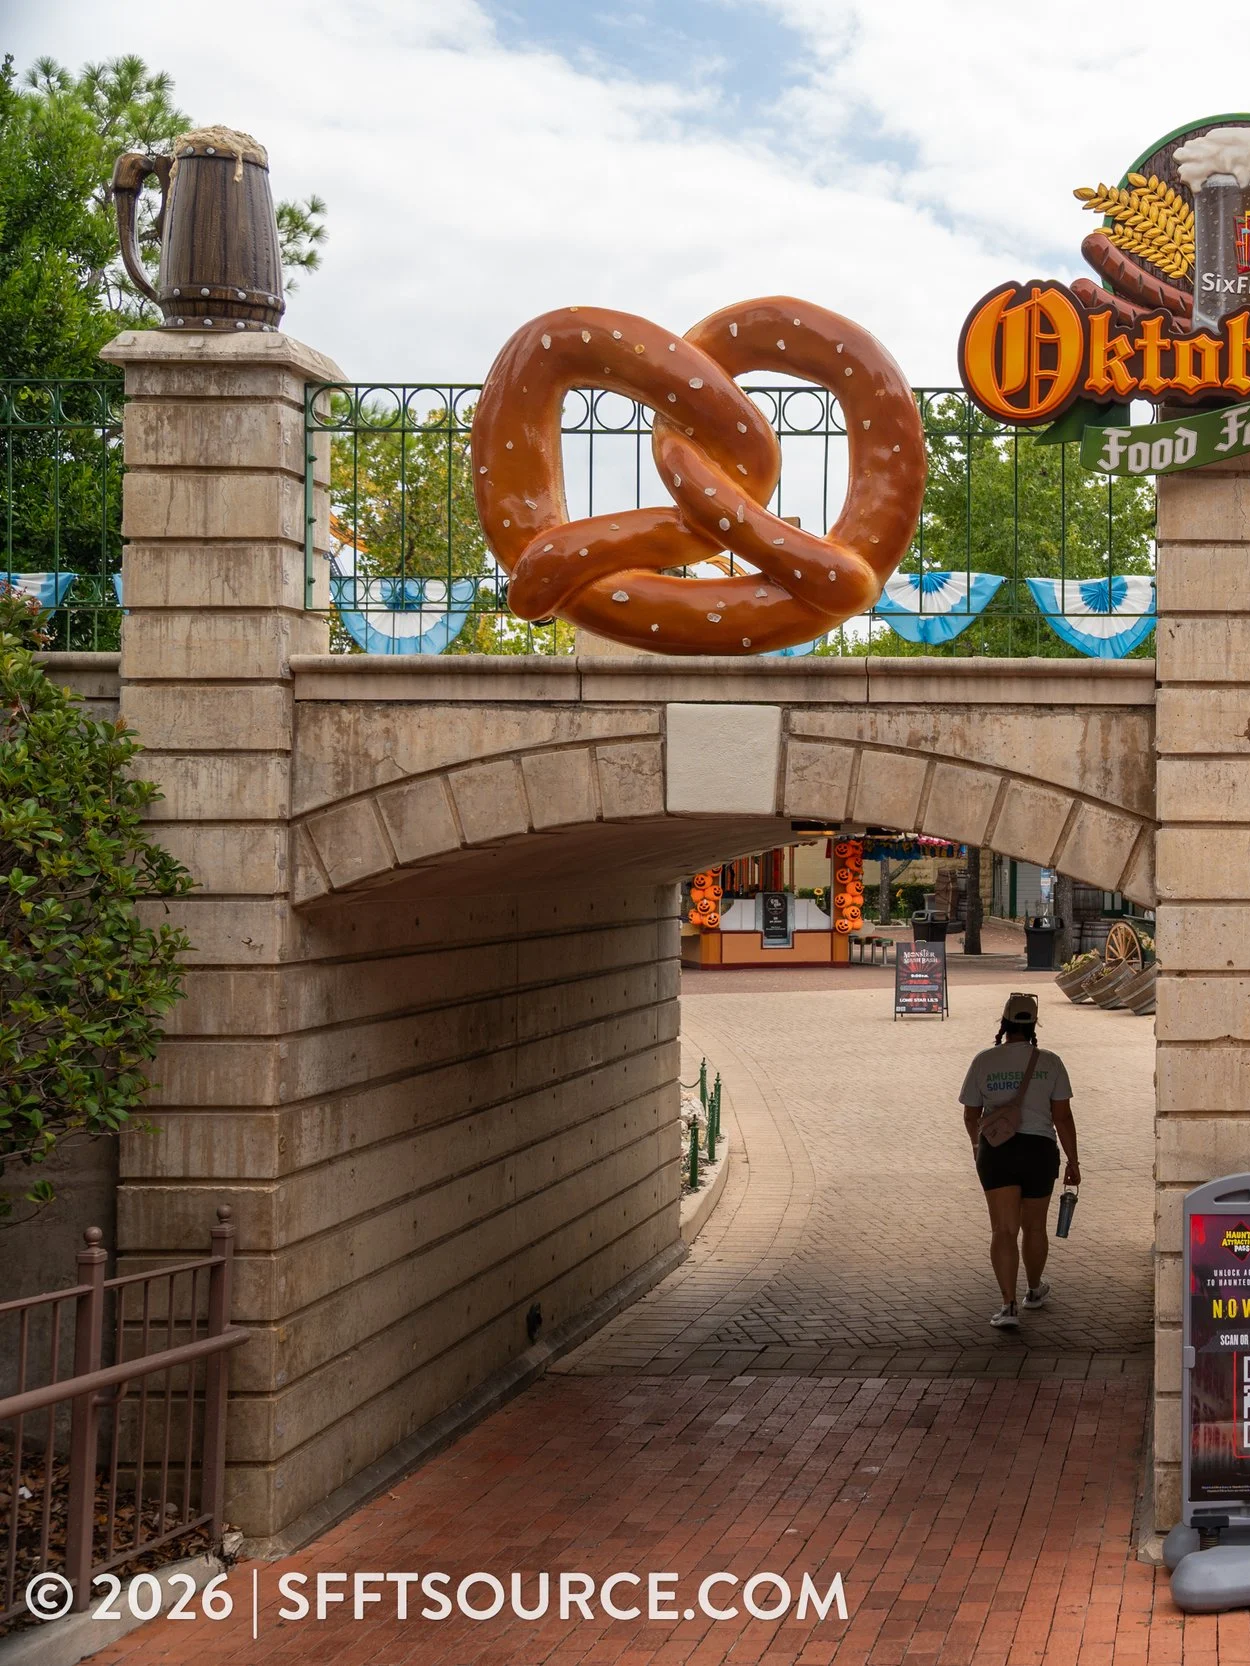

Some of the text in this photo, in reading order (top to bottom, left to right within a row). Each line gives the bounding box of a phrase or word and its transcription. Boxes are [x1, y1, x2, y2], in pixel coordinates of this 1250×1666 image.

[1097, 427, 1197, 473] Food
[987, 1081, 1022, 1091] SOURC
[1213, 1269, 1240, 1277] UNLOCK
[1207, 1279, 1215, 1287] TO
[1220, 1334, 1238, 1345] SCAN
[1240, 1334, 1248, 1345] OR
